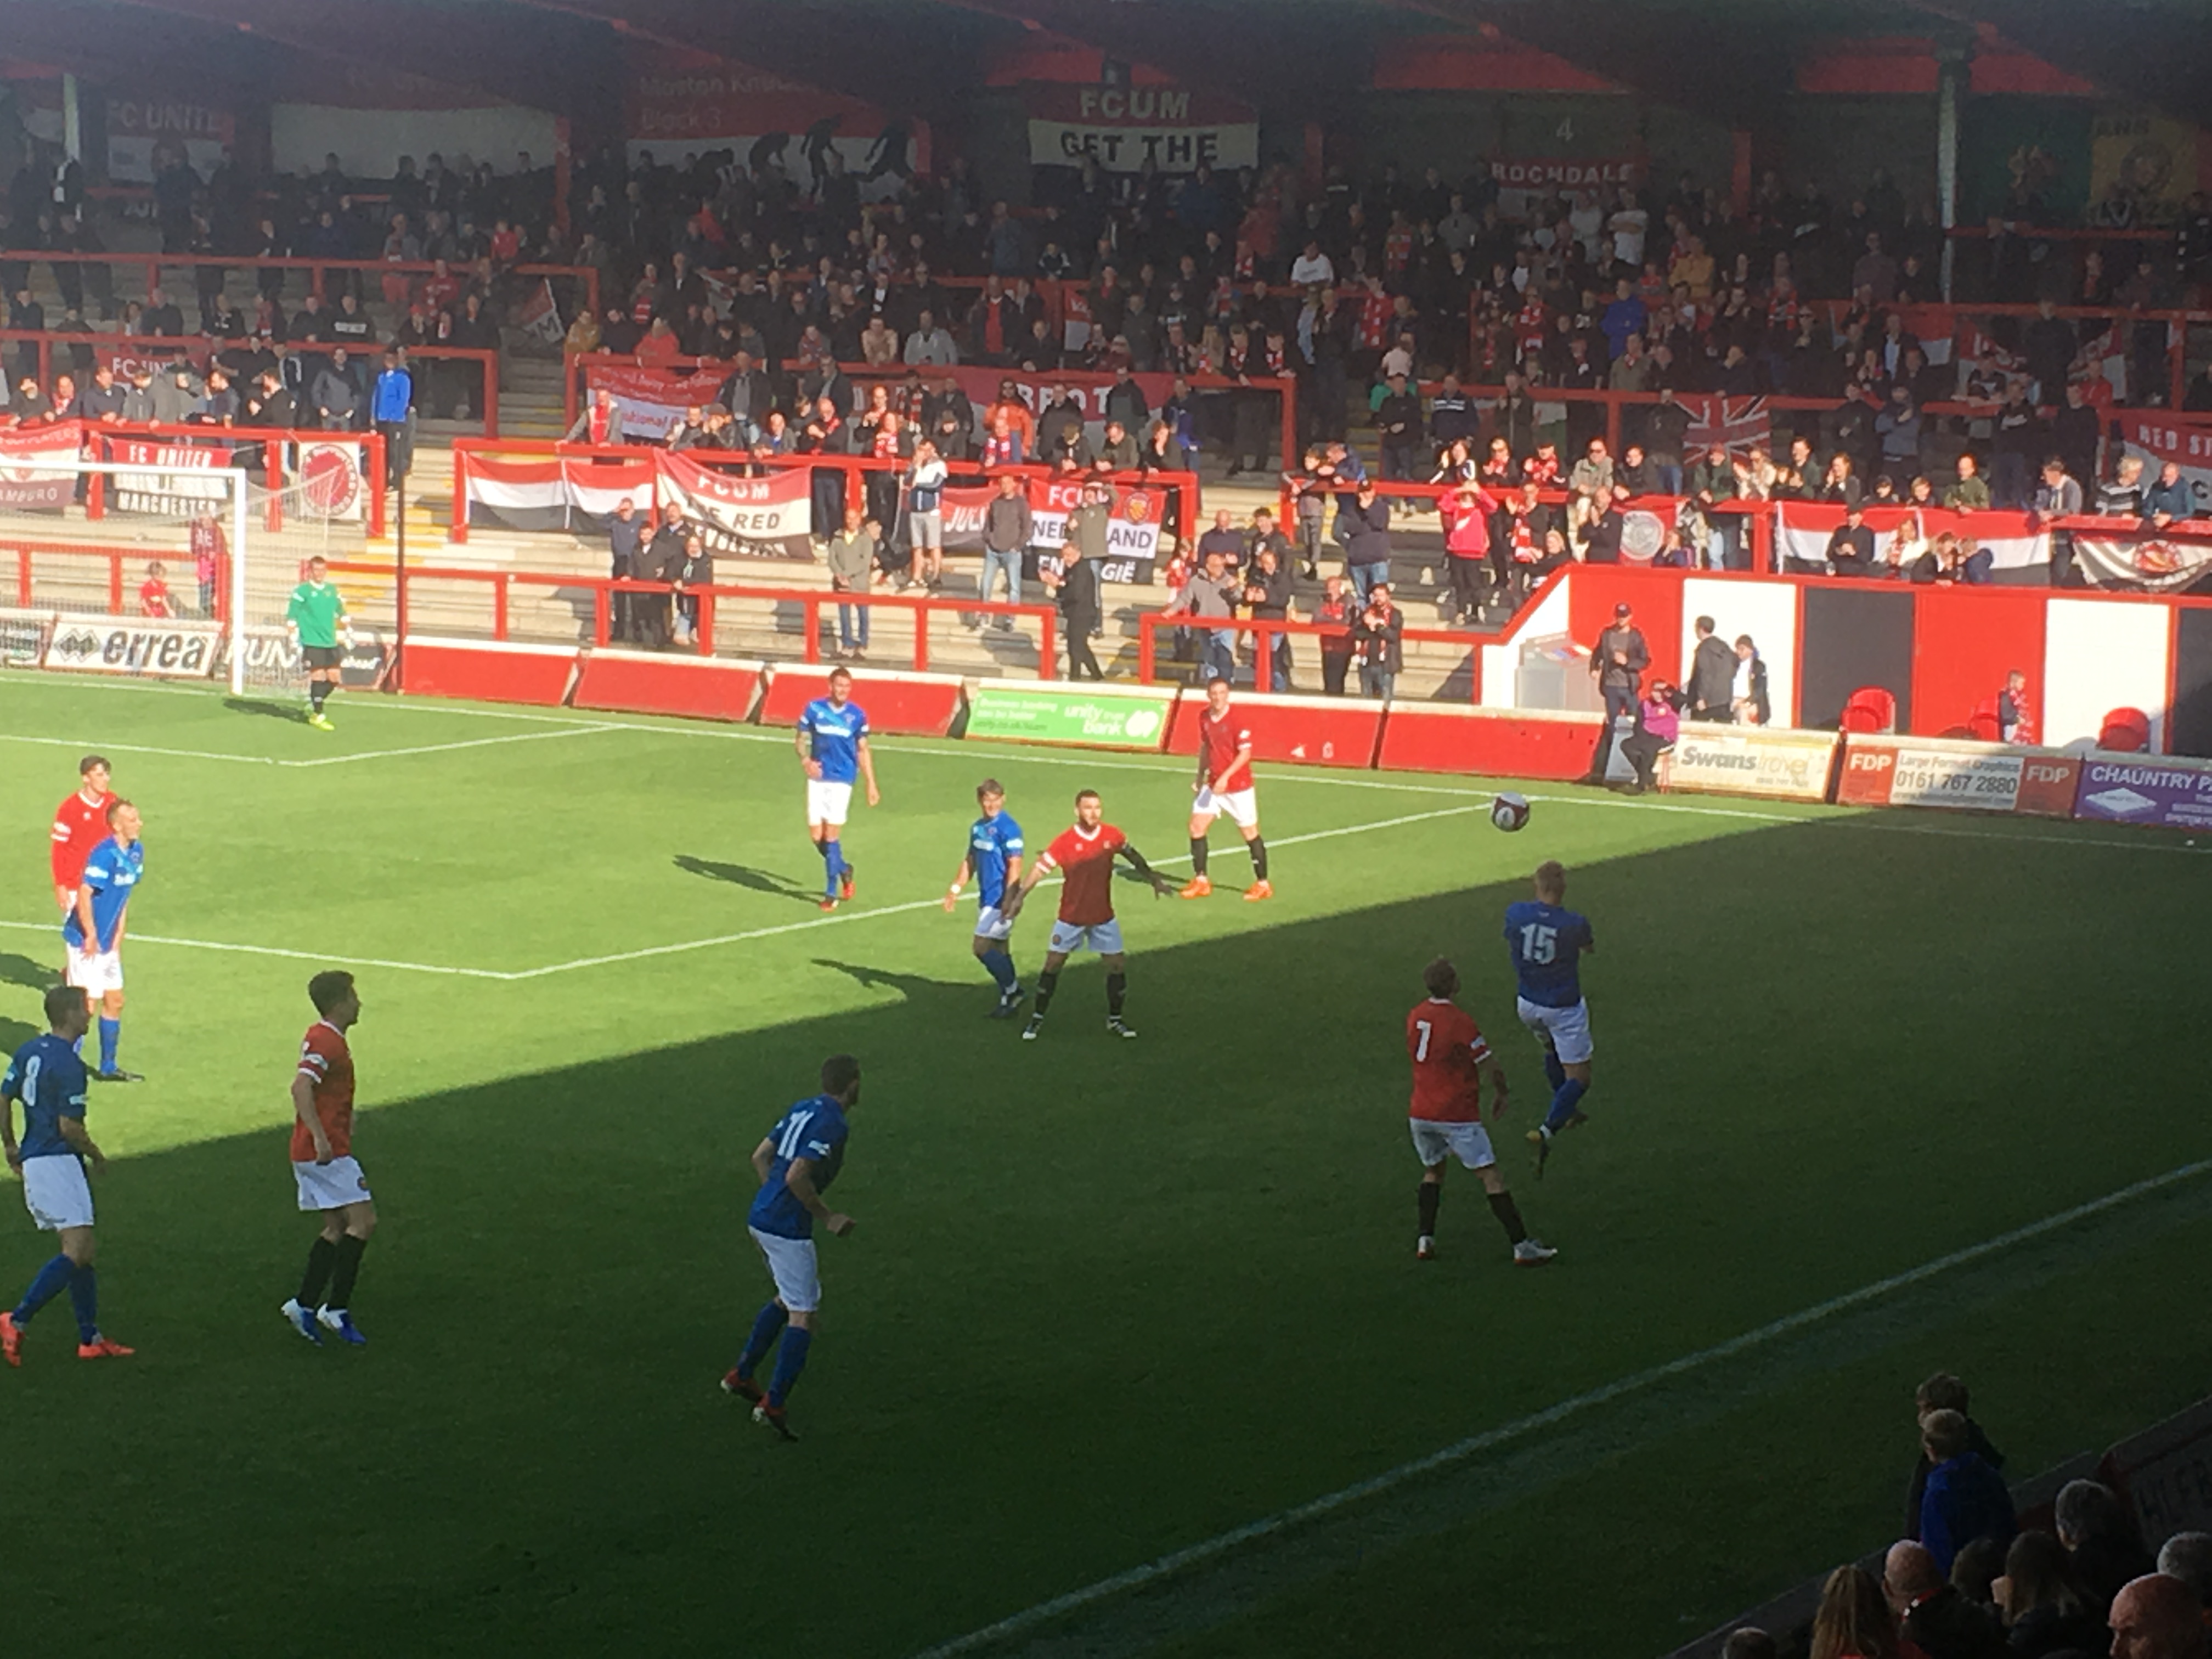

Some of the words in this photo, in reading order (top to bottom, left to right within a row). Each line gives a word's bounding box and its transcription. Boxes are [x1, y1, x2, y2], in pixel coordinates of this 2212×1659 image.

[1079, 89, 1190, 119] FCUM
[1061, 133, 1123, 162] GET
[1141, 133, 1217, 164] THE
[1491, 161, 1635, 185] ROCHDALE
[113, 357, 136, 378] FC
[2139, 425, 2177, 450] RED
[129, 444, 147, 463] FC
[157, 448, 212, 467] UNITED
[698, 475, 770, 500] FCUM
[117, 490, 217, 517] MANCHESTER
[733, 512, 780, 530] RED
[1064, 703, 1104, 723] unity
[1081, 719, 1122, 736] bank
[1681, 746, 1757, 770] Swans
[1850, 753, 1893, 772] FDP
[1896, 770, 1935, 789] 0161
[1941, 774, 1973, 791] 767
[1976, 776, 2018, 794] 2880
[2027, 764, 2070, 784] FDP
[2091, 765, 2195, 790] CHAUNTRY
[1521, 923, 1558, 965] 15
[1417, 1020, 1431, 1063] 7
[22, 1055, 42, 1107] 8
[777, 1110, 815, 1161] 11
